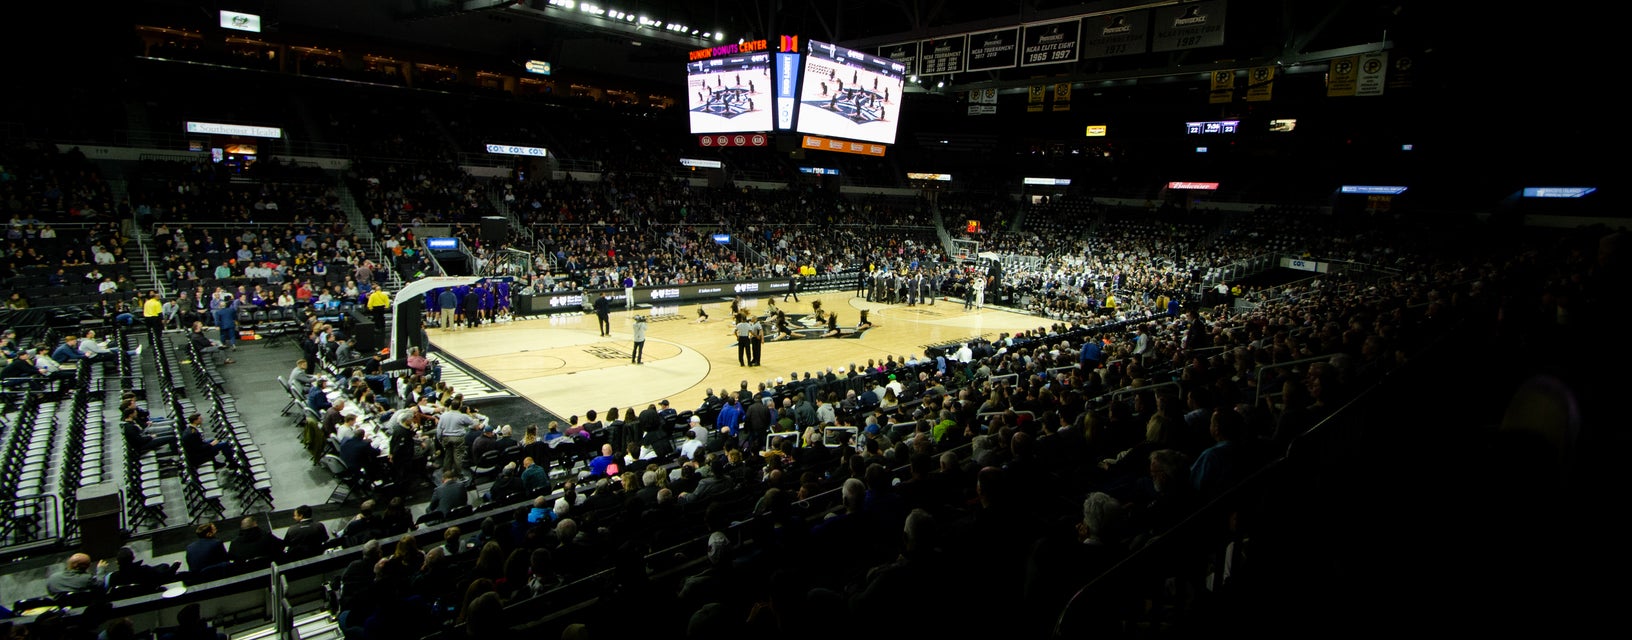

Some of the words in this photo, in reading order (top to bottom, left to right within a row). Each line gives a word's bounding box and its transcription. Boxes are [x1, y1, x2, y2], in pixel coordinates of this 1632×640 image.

[1041, 43, 1057, 51] ELITE
[1058, 41, 1075, 49] EIGHT
[1177, 36, 1201, 47] 1987
[713, 44, 738, 57] DONUTS
[739, 39, 767, 52] CENTER
[1029, 52, 1048, 62] 1965
[1051, 49, 1071, 60] 1997
